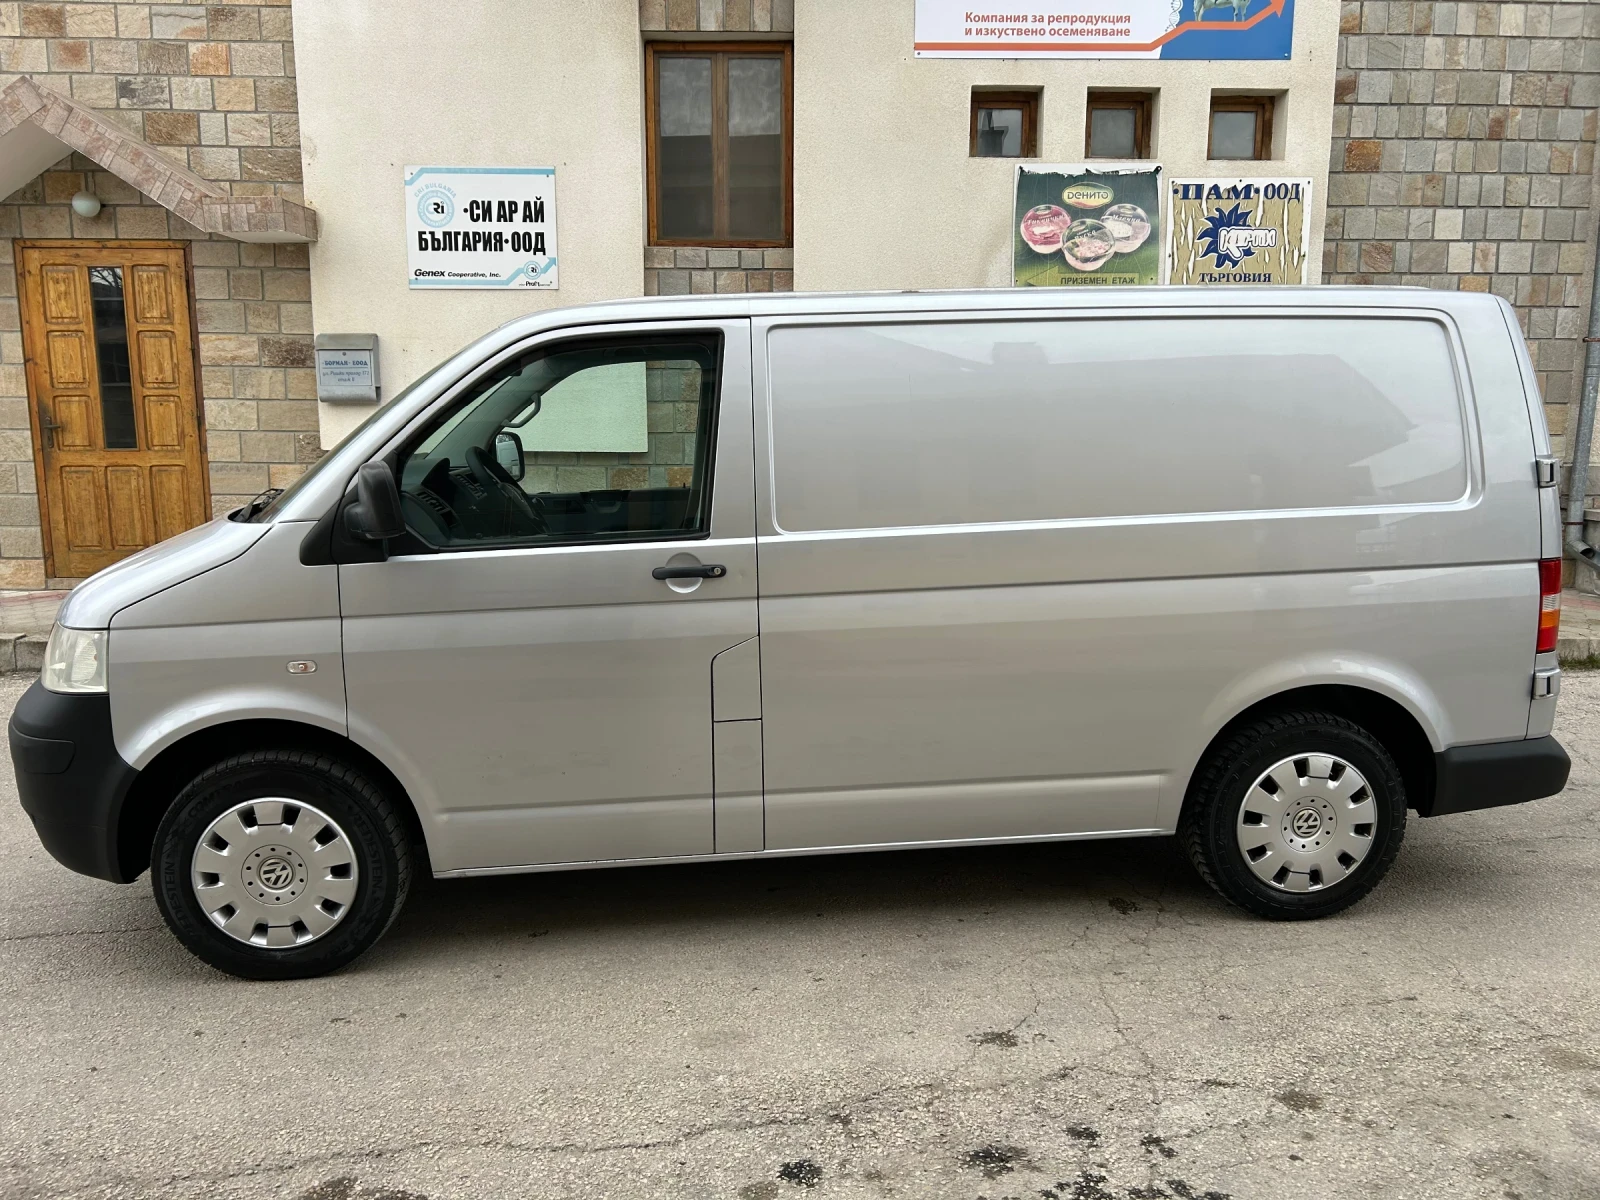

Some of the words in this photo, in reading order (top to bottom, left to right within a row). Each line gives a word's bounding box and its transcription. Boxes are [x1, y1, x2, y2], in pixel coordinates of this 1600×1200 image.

[965, 11, 1028, 23] Компания
[1030, 14, 1045, 23] за
[1047, 14, 1131, 26] репродукция
[964, 27, 973, 36] и
[975, 27, 1046, 39] изкуствено
[1048, 27, 1131, 37] осеменяване
[496, 200, 518, 223] АР
[522, 196, 545, 223] АЙ
[414, 268, 445, 278] Genex
[447, 271, 487, 279] Cooperative,
[1200, 272, 1272, 283] ТЪРГОВИЯ
[1060, 277, 1107, 285] ПРИЗЕМЕН
[1112, 276, 1136, 285] ЕТАЖ
